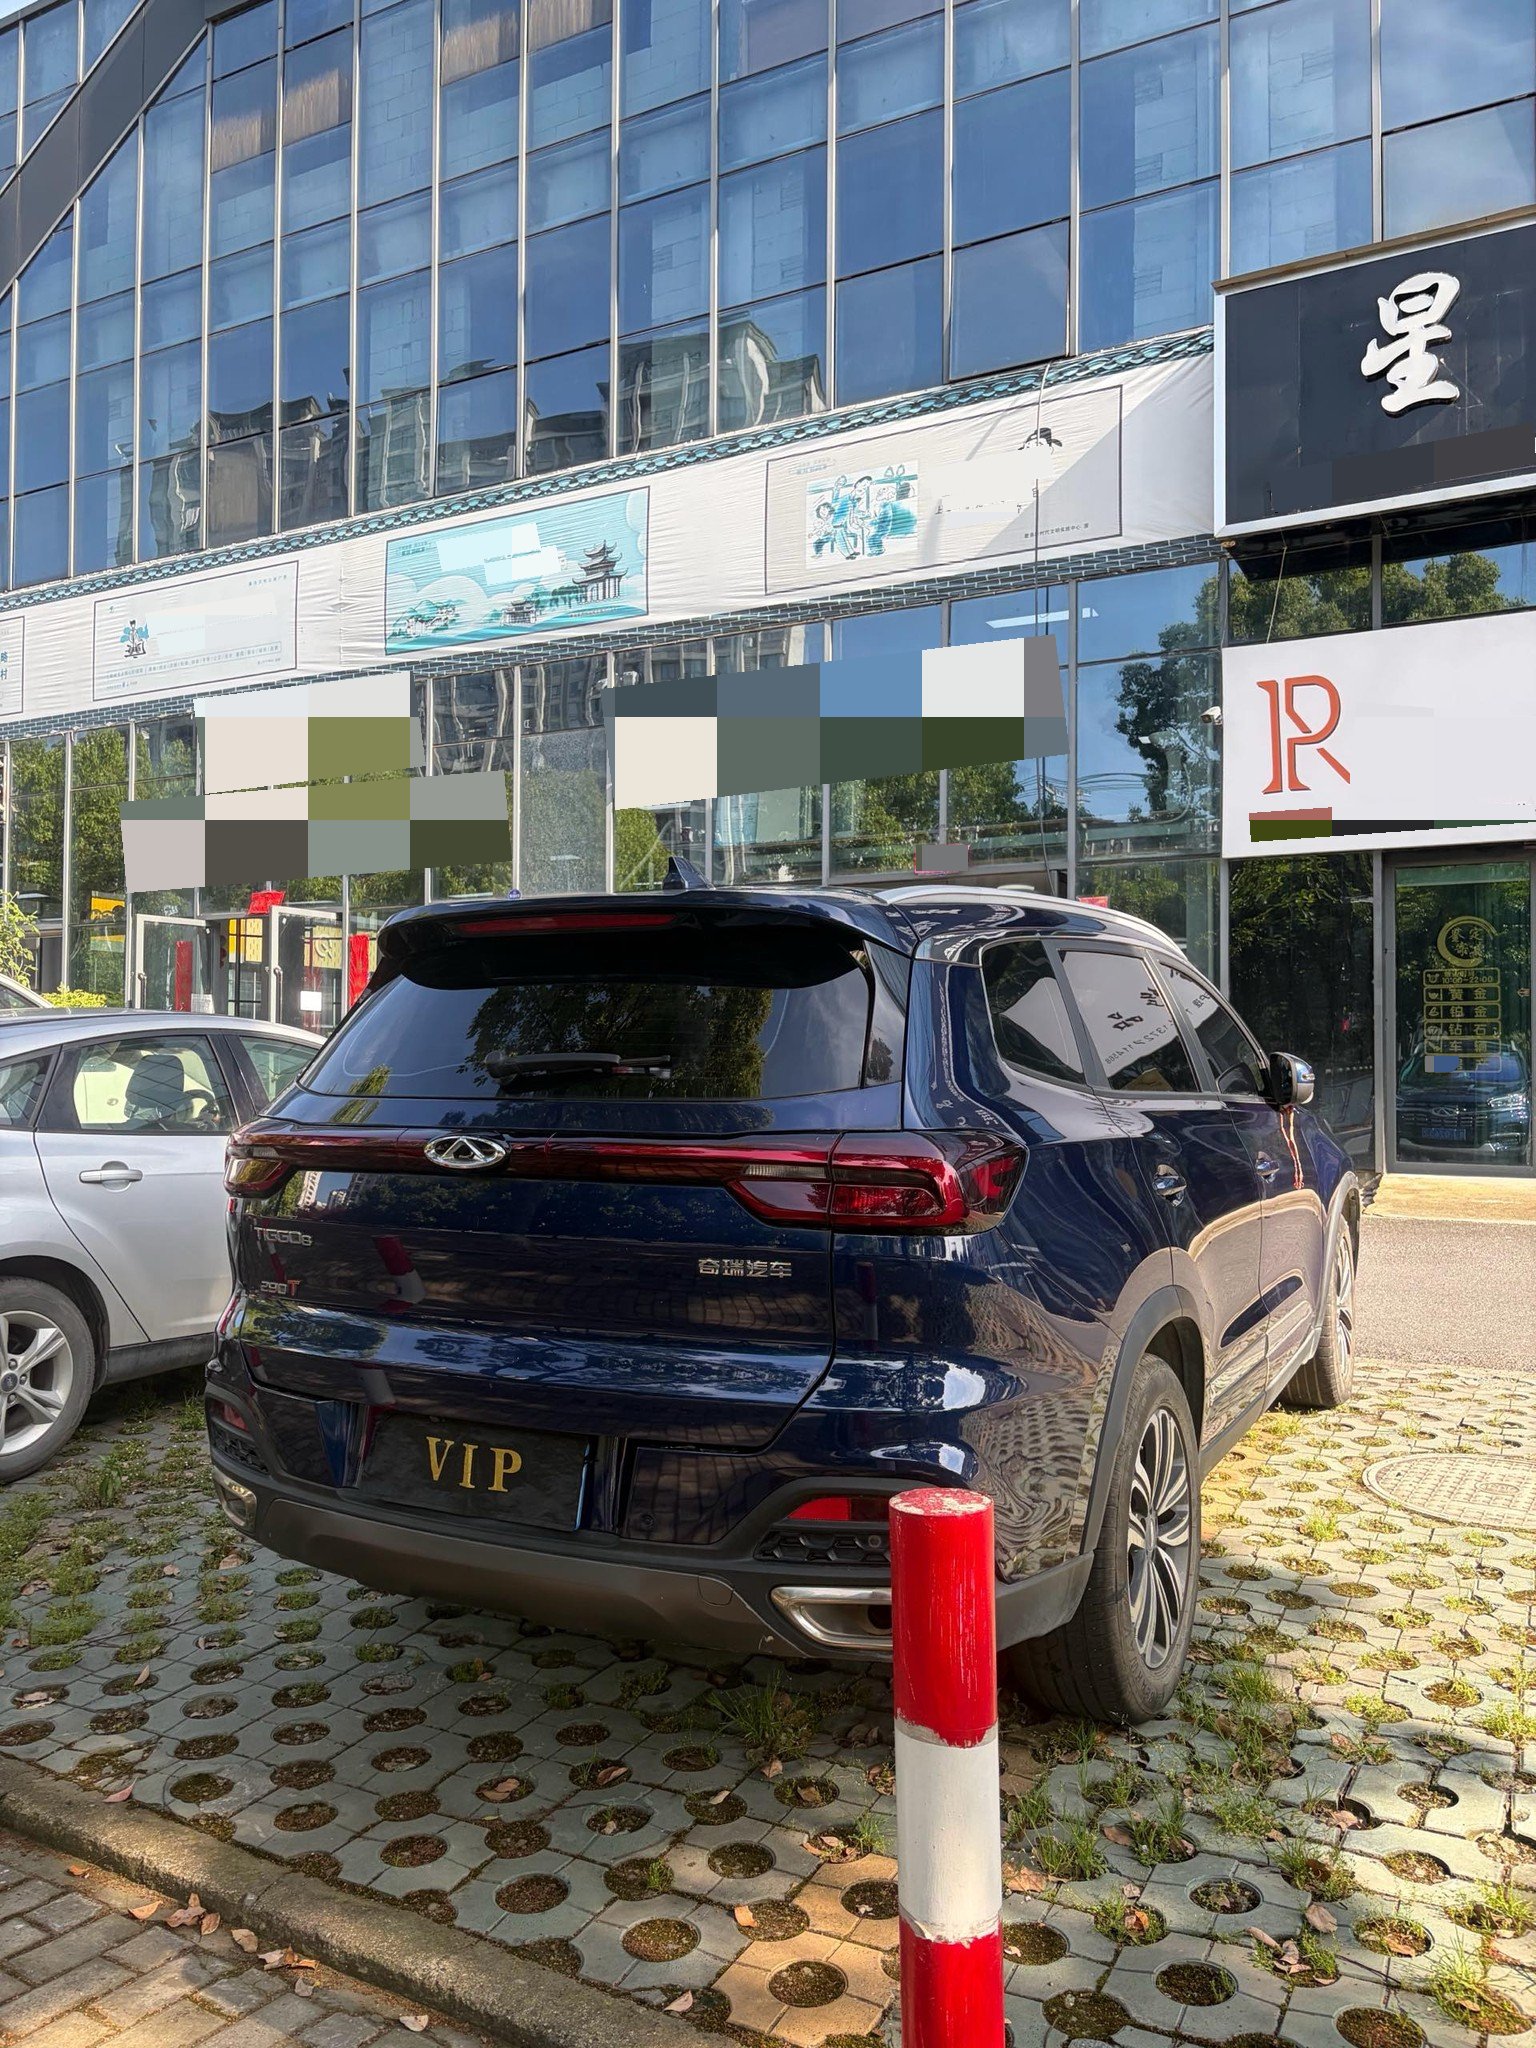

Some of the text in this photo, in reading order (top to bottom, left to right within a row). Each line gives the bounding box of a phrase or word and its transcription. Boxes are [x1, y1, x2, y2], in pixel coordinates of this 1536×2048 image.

[1361, 272, 1460, 416] 星
[1449, 1024, 1487, 1036] 钻石
[698, 1258, 792, 1278] 奇瑞汽车
[426, 1436, 522, 1493] VIP
